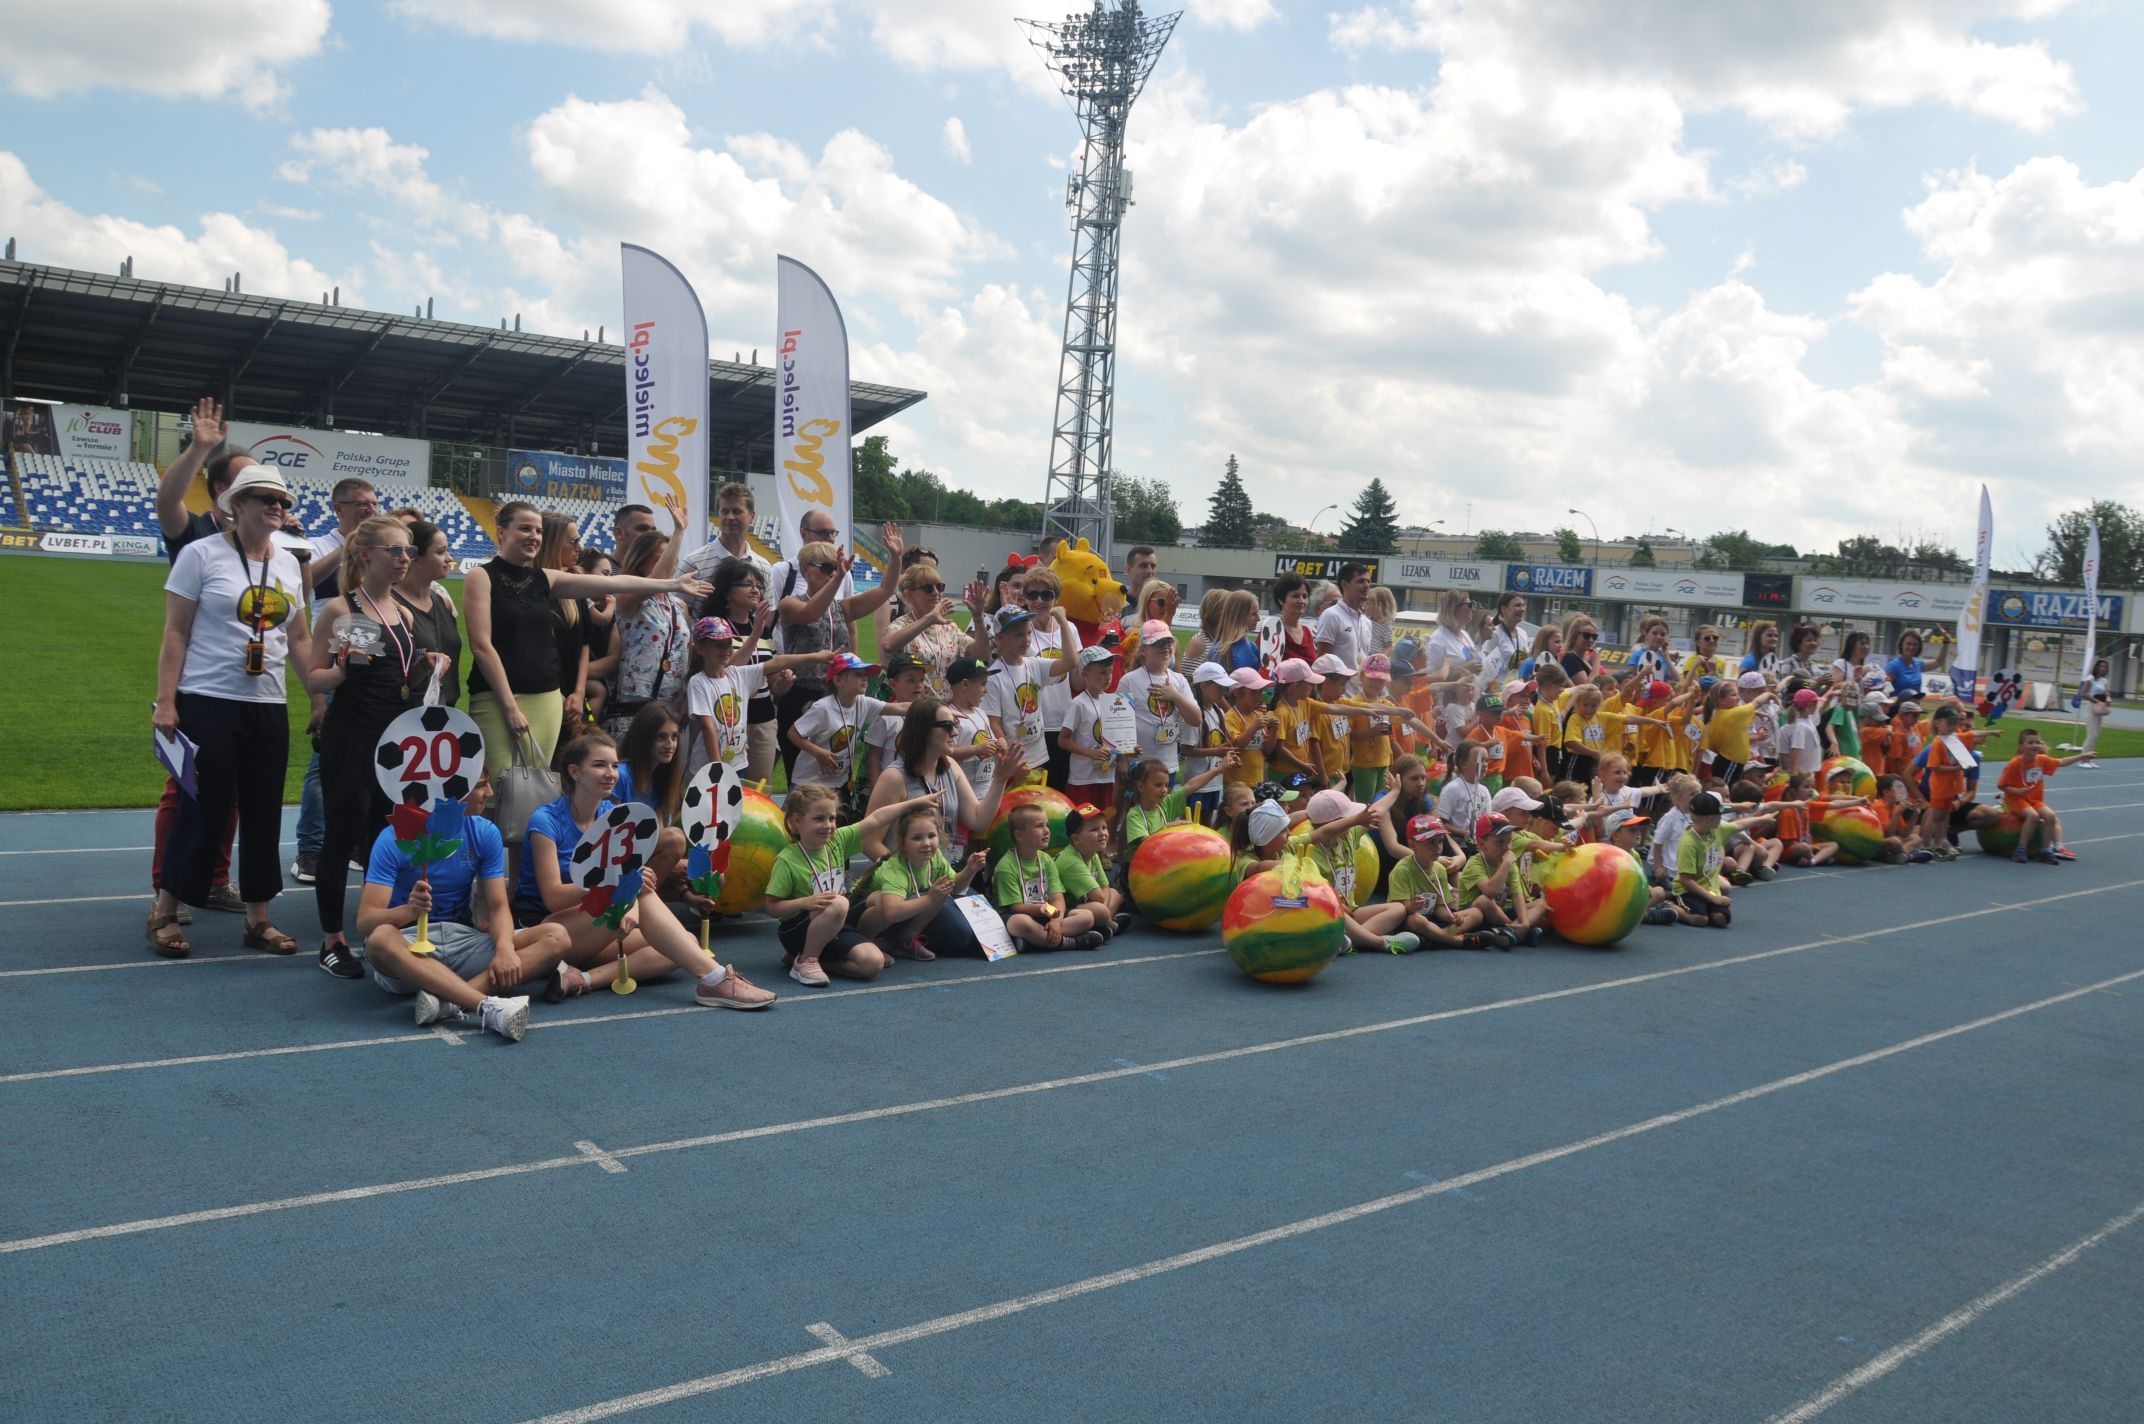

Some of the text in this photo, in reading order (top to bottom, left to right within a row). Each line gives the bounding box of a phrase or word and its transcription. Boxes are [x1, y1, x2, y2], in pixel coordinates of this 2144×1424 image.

[88, 426, 122, 435] CLUB
[84, 442, 112, 451] formie
[260, 450, 309, 468] PGE
[336, 451, 410, 467] Polska Grupa
[333, 462, 407, 478] Energetyczna
[548, 461, 624, 482] Miasto Mielec
[547, 481, 603, 501] RAZEM
[0, 534, 38, 547] BET
[48, 539, 108, 550] LVBET.PL
[113, 540, 151, 551] KINGA
[1535, 567, 1586, 588] RAZEM
[1814, 594, 1836, 603] PGE
[1898, 599, 1921, 608] PGE
[2032, 594, 2112, 620] RAZEM
[1026, 725, 1038, 736] 41
[399, 731, 462, 782] 20
[704, 783, 721, 829] 1
[591, 821, 636, 870] 13
[1027, 885, 1039, 897] 24
